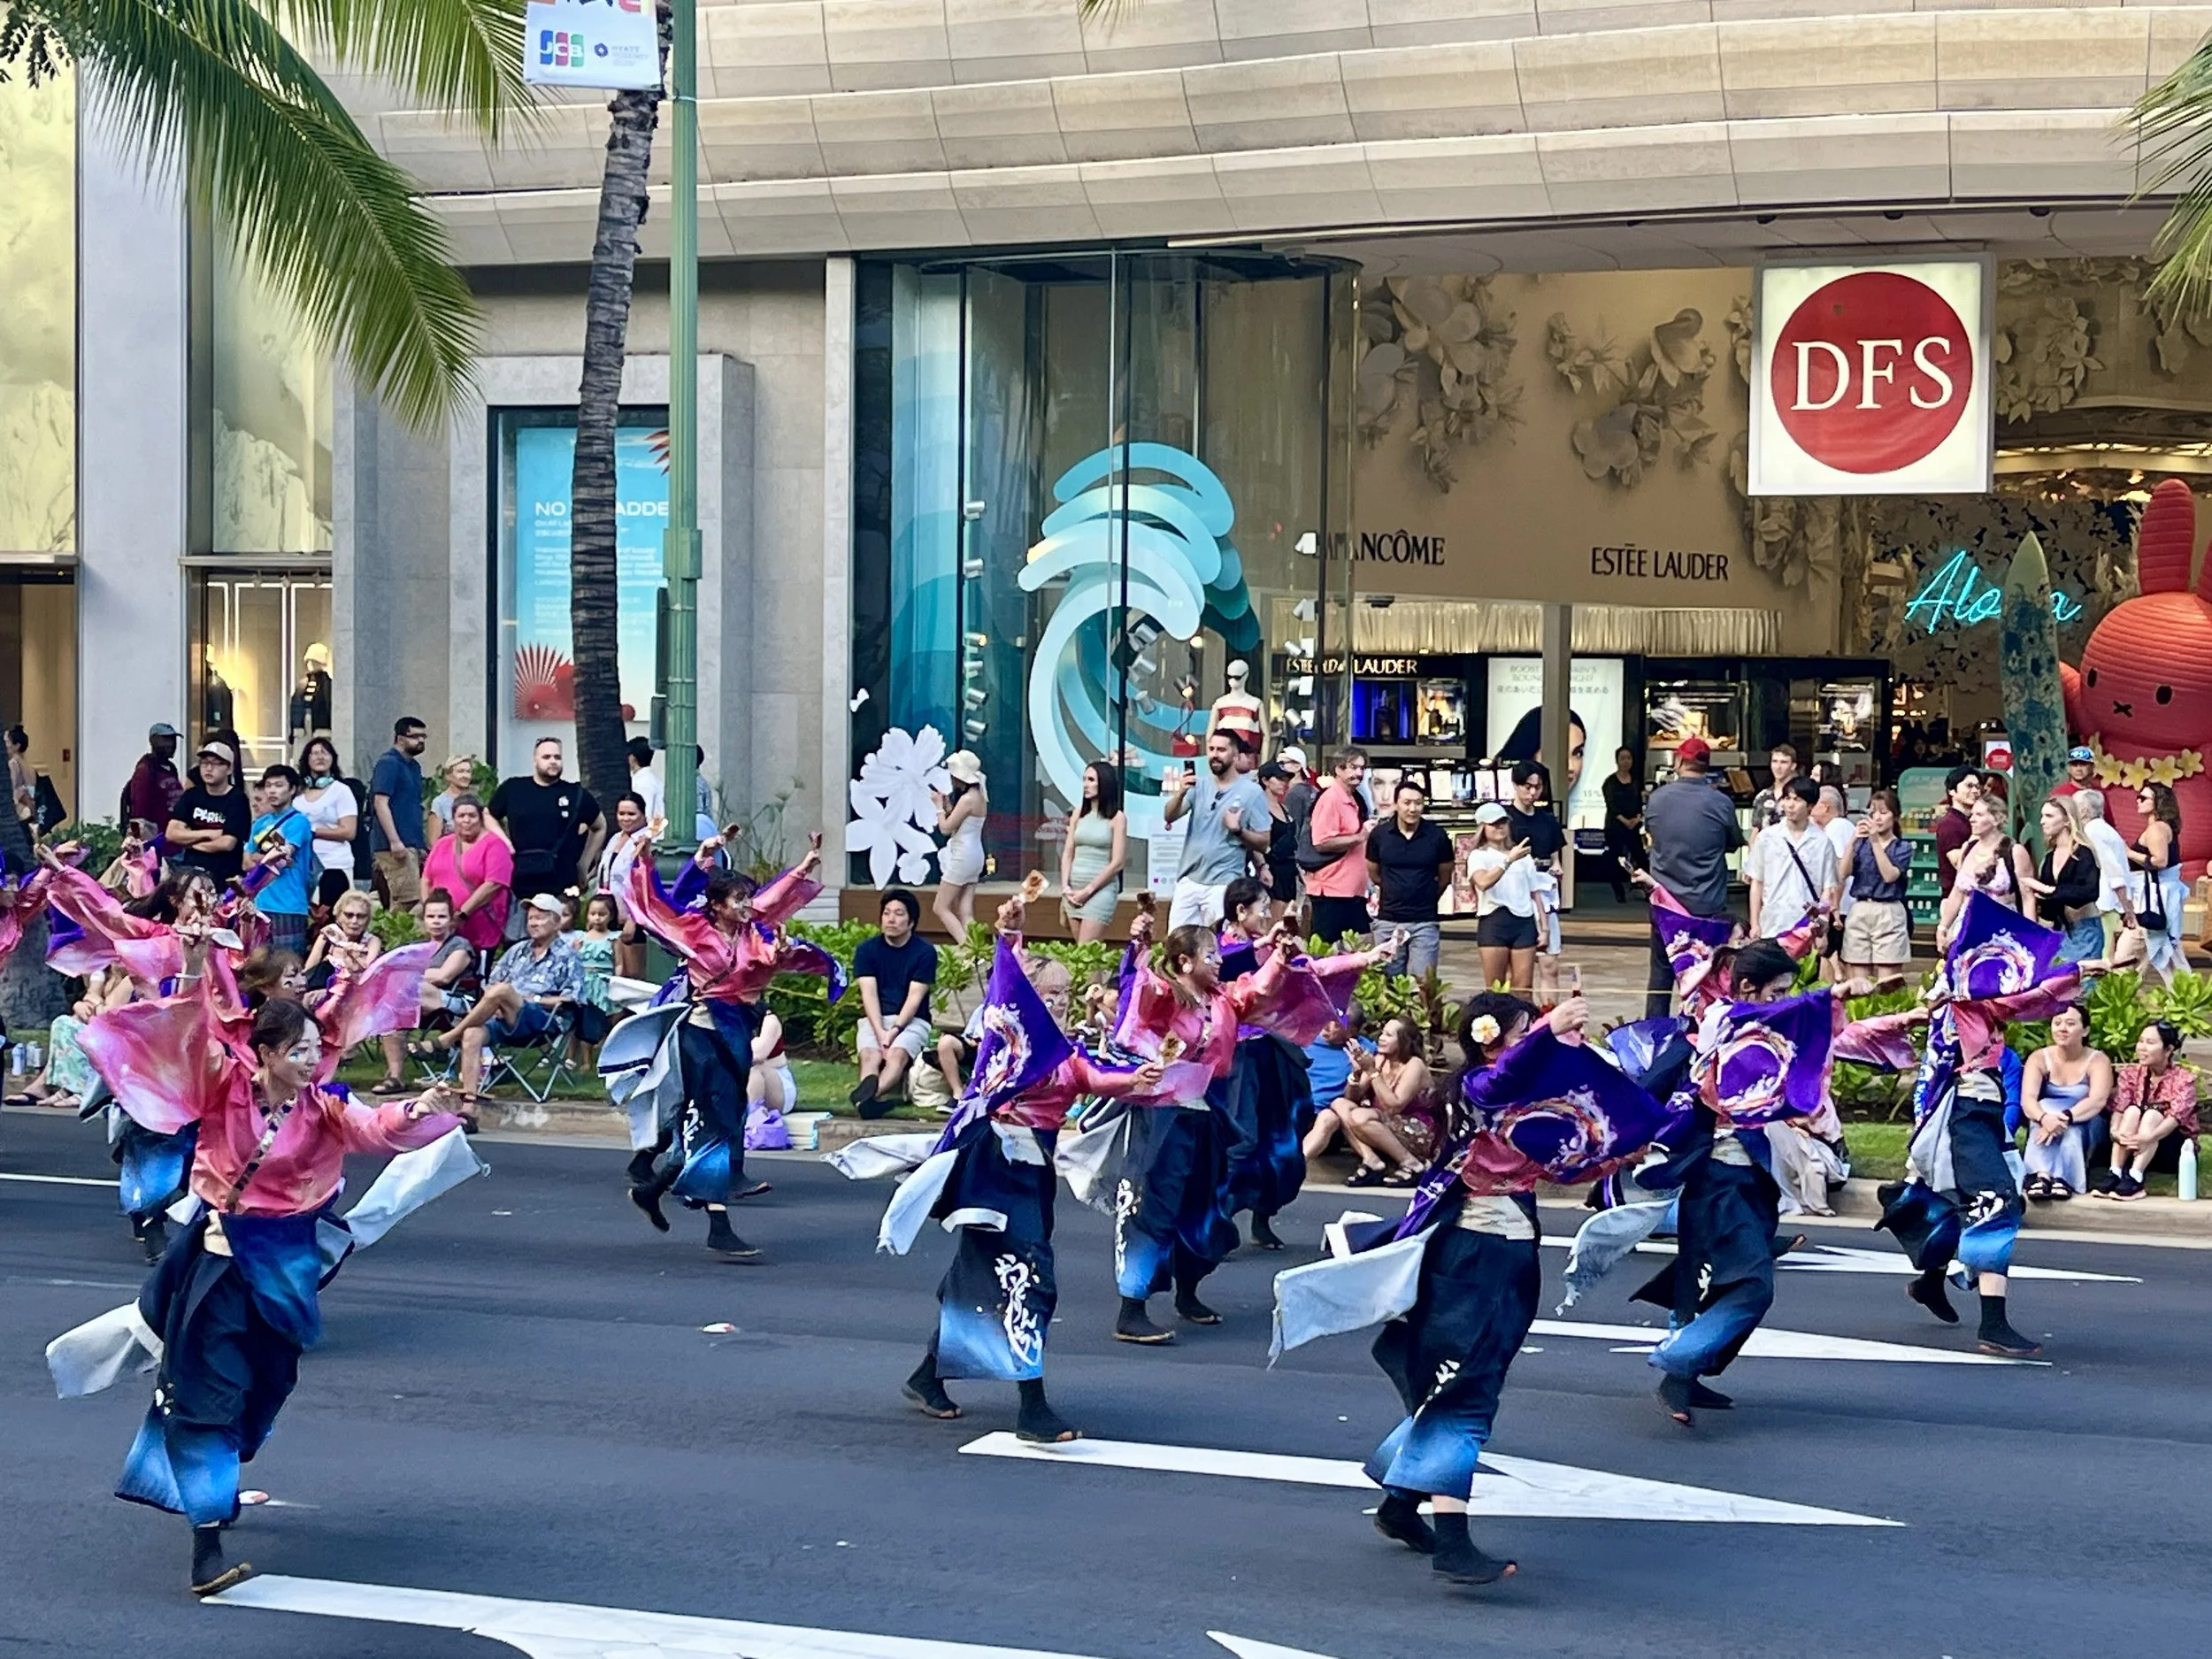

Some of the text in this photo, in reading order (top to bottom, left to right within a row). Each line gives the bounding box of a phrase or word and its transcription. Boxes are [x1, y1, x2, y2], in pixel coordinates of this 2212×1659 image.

[539, 40, 584, 59] JCB
[1790, 336, 1954, 411] DFS
[534, 501, 669, 517] NO ADDE
[1353, 528, 1446, 566] NCÔME
[1654, 550, 1729, 581] LAUDER
[1904, 549, 2083, 635] Aloa
[1353, 658, 1417, 675] LAUDER
